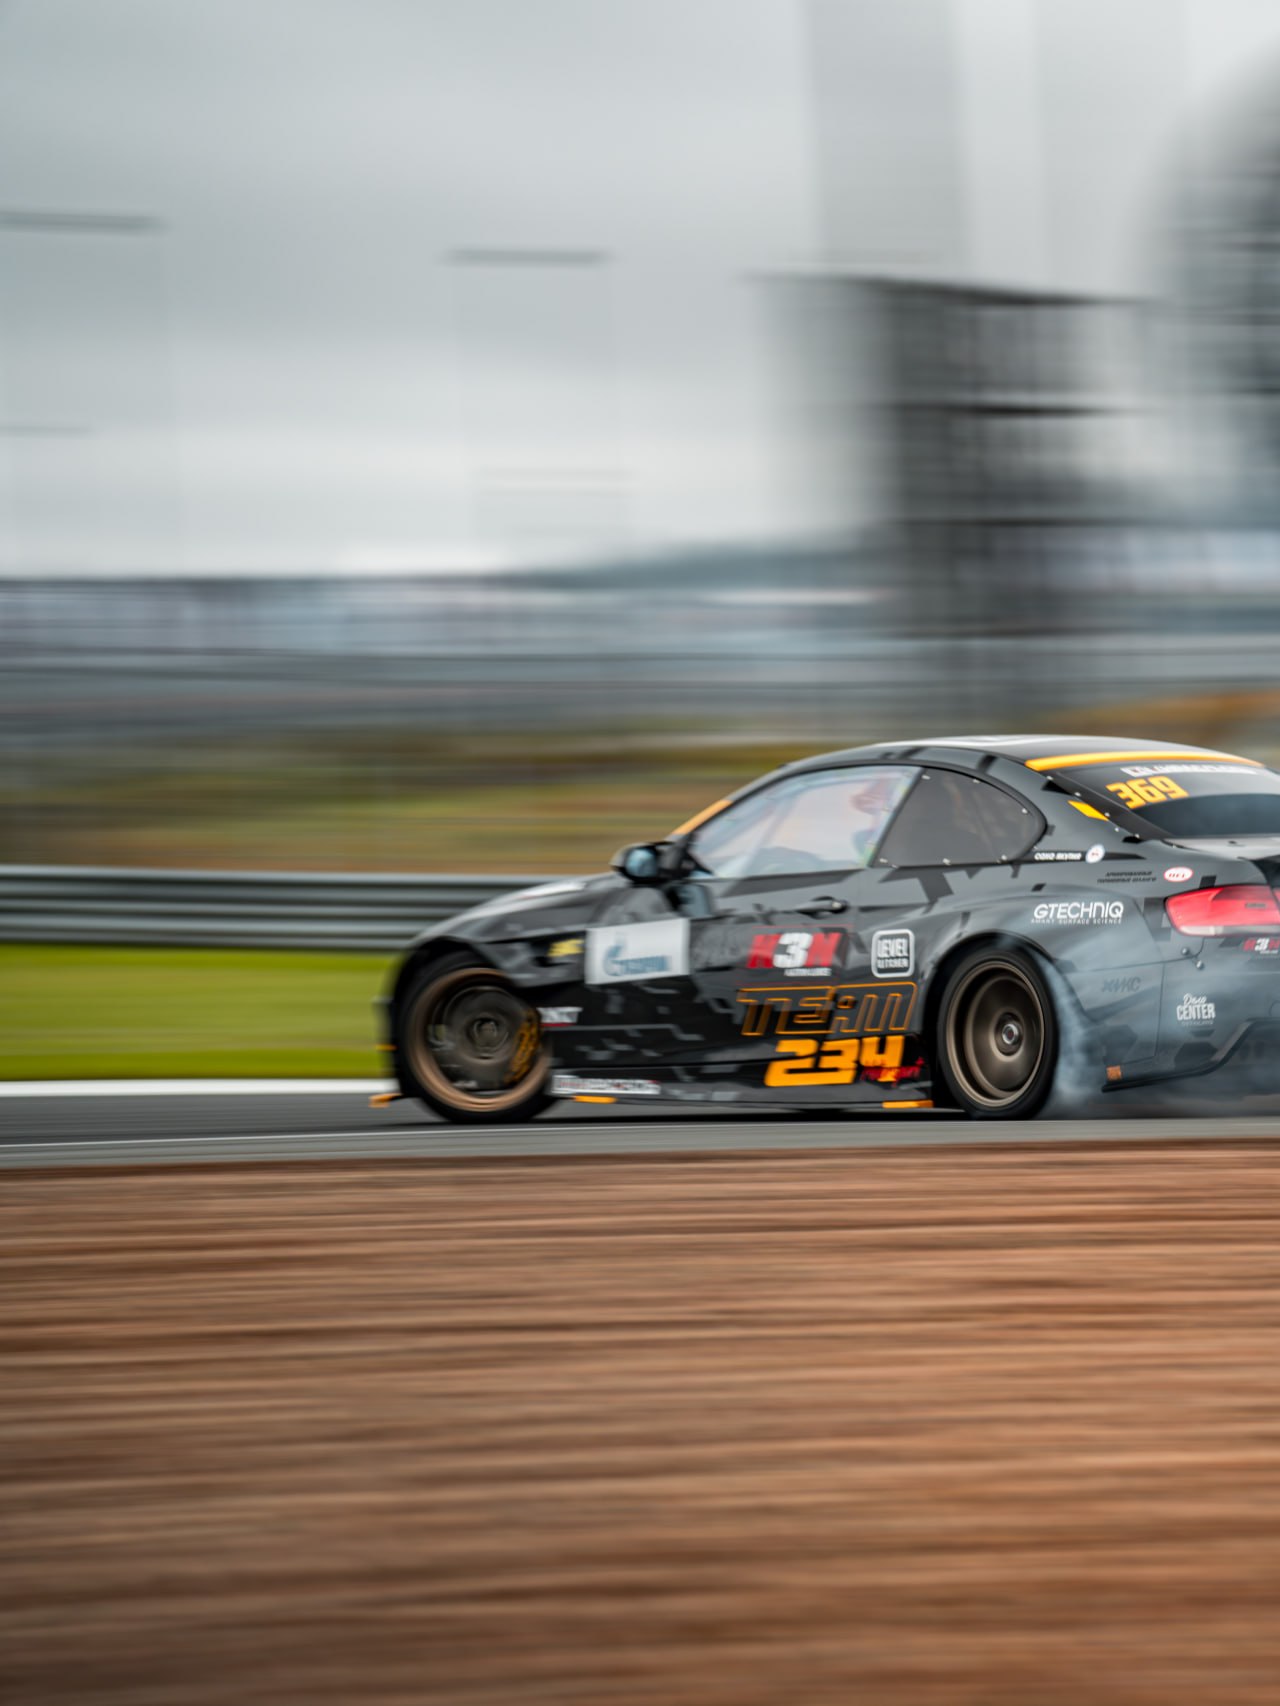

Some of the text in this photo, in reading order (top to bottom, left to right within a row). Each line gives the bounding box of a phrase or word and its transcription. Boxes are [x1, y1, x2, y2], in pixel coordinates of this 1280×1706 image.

[1105, 775, 1190, 810] 369
[1033, 901, 1124, 919] GTECHNIQ
[876, 937, 909, 959] LEVEL
[1176, 1003, 1216, 1021] CENTER
[764, 1034, 905, 1088] 234
